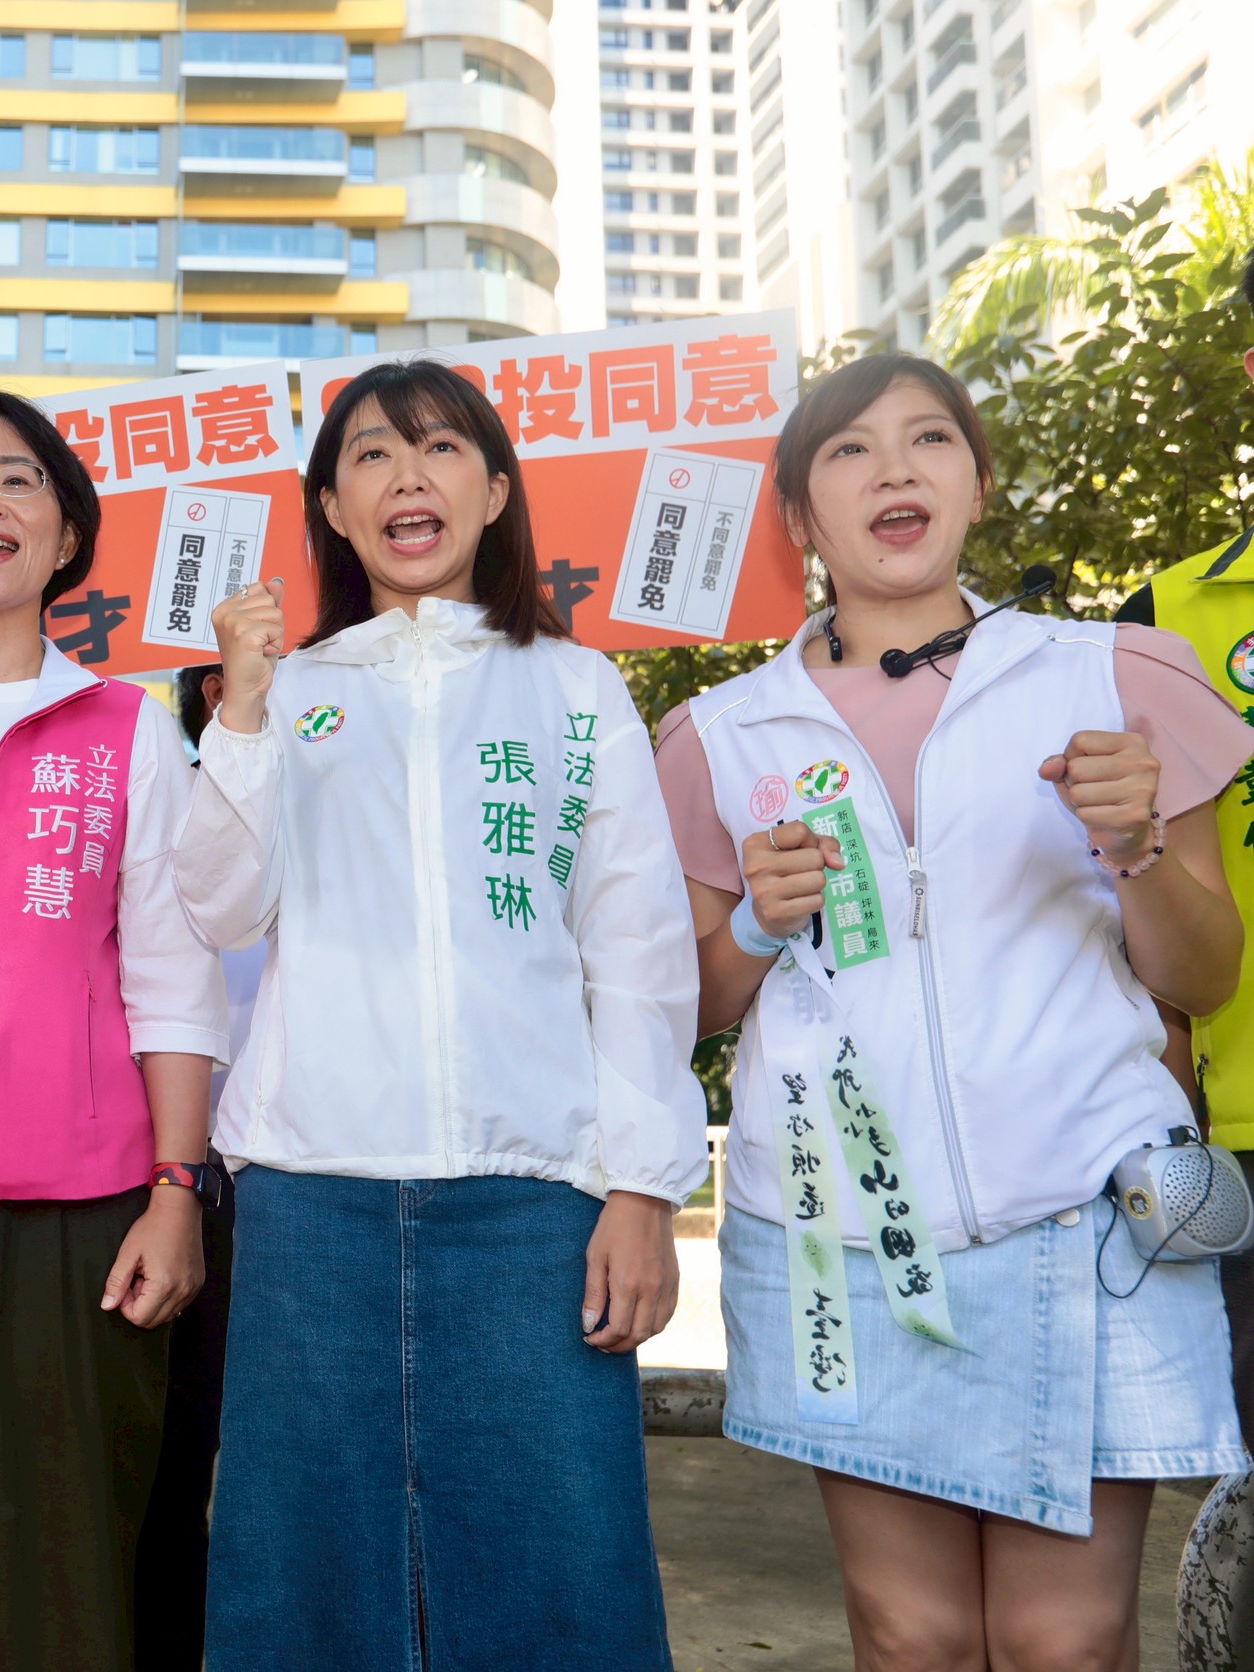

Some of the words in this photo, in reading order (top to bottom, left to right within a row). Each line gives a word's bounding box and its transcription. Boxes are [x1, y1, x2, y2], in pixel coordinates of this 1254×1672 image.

[446, 333, 779, 447] 投同意
[166, 533, 206, 633] 同意罷免
[636, 501, 687, 612] 同意罷免
[699, 510, 736, 593] 不同意罷免
[22, 752, 81, 920] 蘇巧慧
[79, 743, 118, 879] 立法委員
[476, 740, 537, 932] 張雅琳
[547, 711, 598, 890] 立法委員
[812, 813, 868, 958] 新市議員
